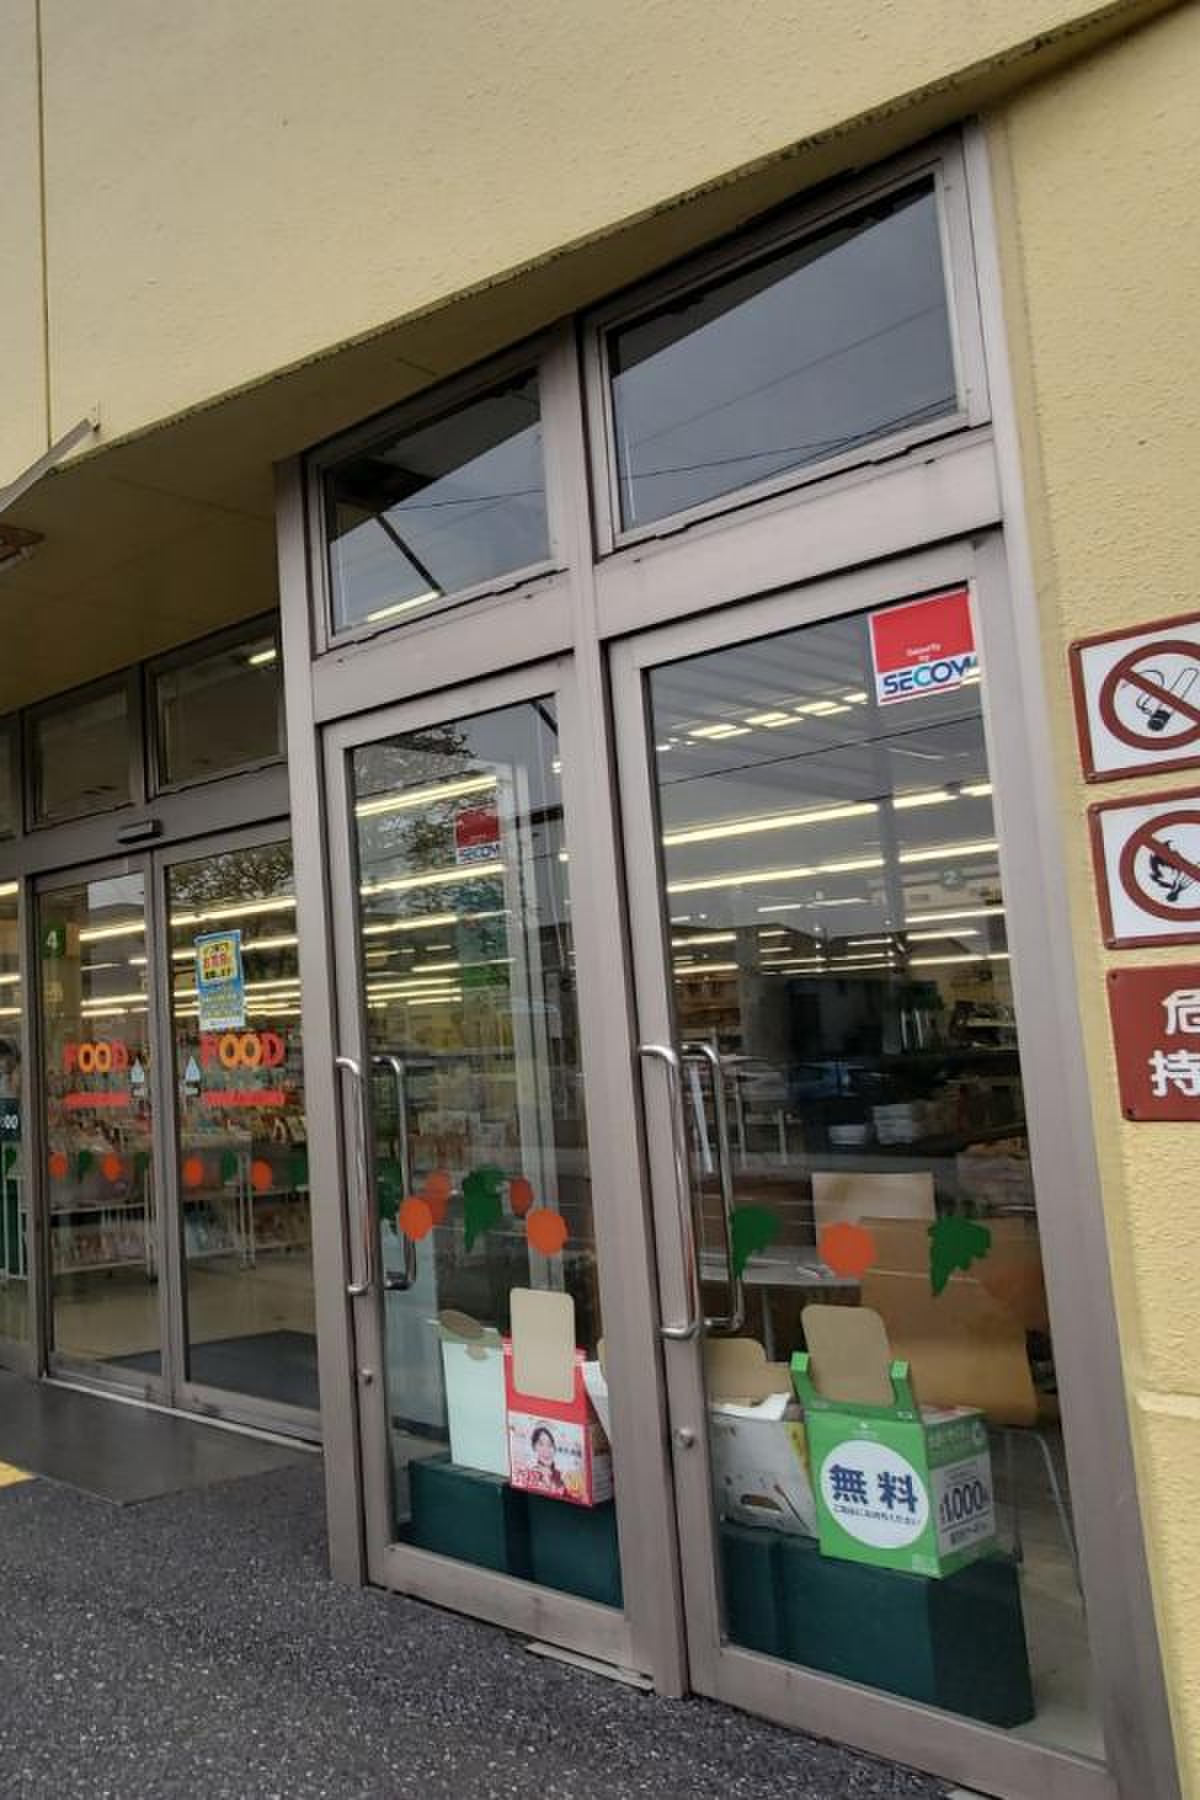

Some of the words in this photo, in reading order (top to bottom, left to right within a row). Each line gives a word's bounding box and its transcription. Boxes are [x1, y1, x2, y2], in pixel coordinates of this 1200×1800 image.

[63, 1040, 129, 1074] FOOD
[201, 1031, 286, 1069] FOOD
[828, 1463, 918, 1514] 無料
